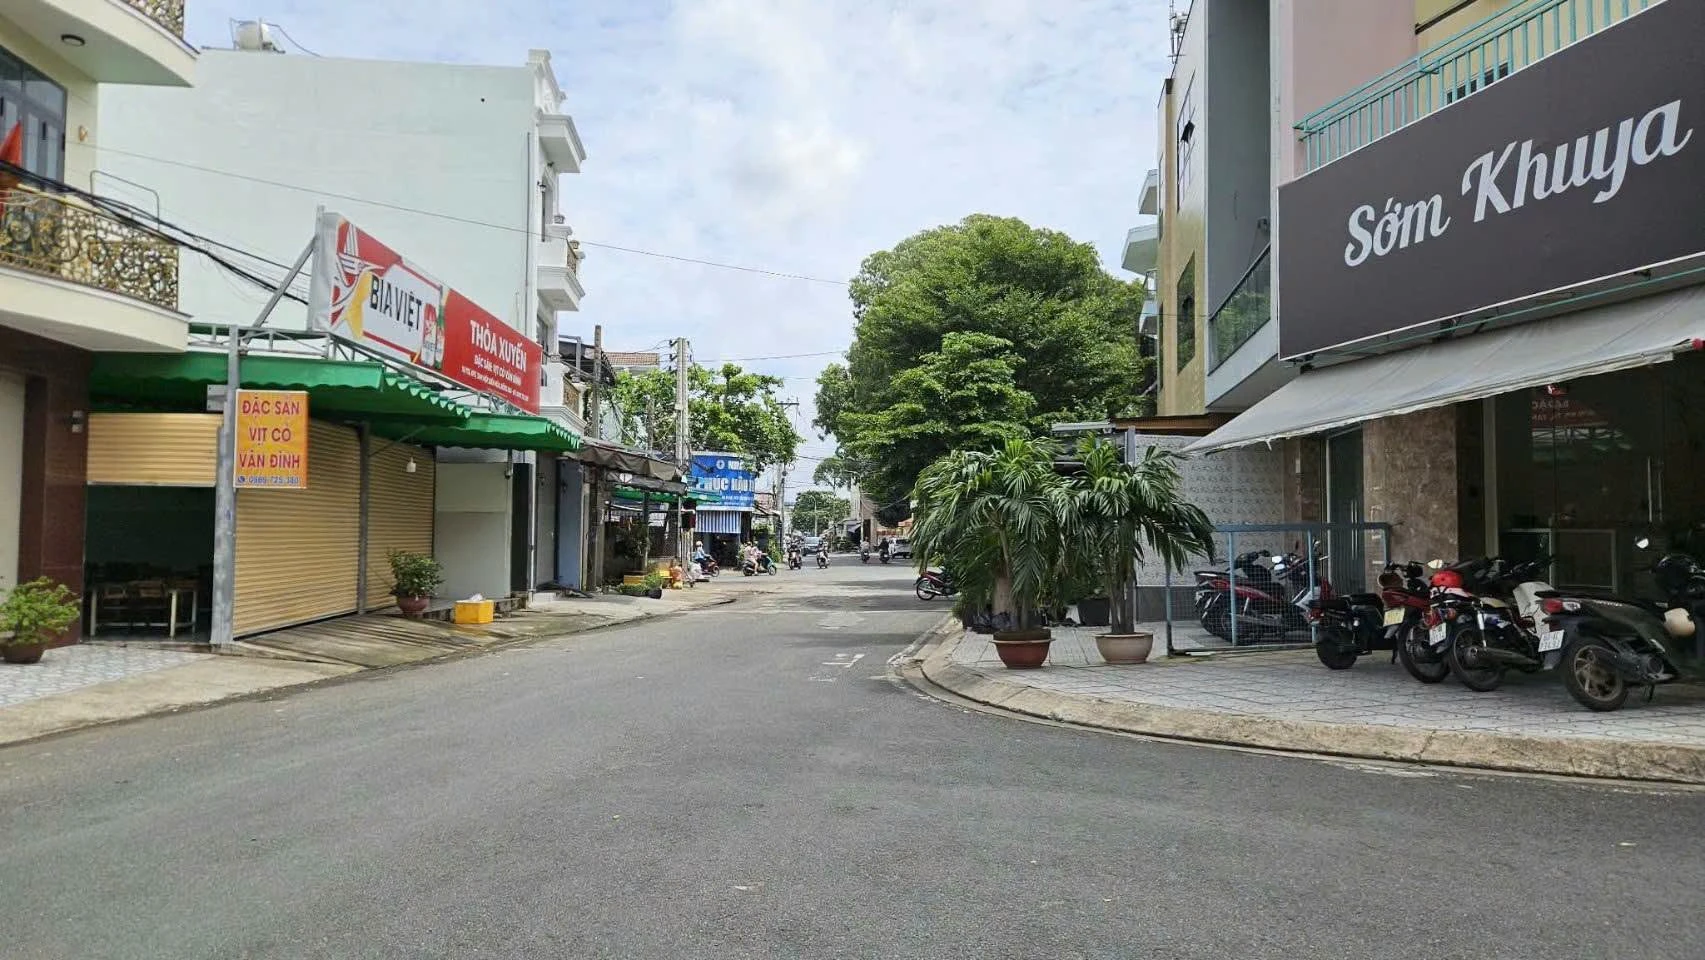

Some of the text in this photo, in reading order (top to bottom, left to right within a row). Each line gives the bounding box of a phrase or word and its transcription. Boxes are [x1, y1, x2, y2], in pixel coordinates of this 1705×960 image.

[1344, 99, 1694, 267] Sớm Khuya
[370, 275, 422, 332] BIA VIỆT
[242, 396, 270, 418] ĐẶC
[249, 427, 268, 446] VỊT
[269, 450, 300, 469] ĐÌNH
